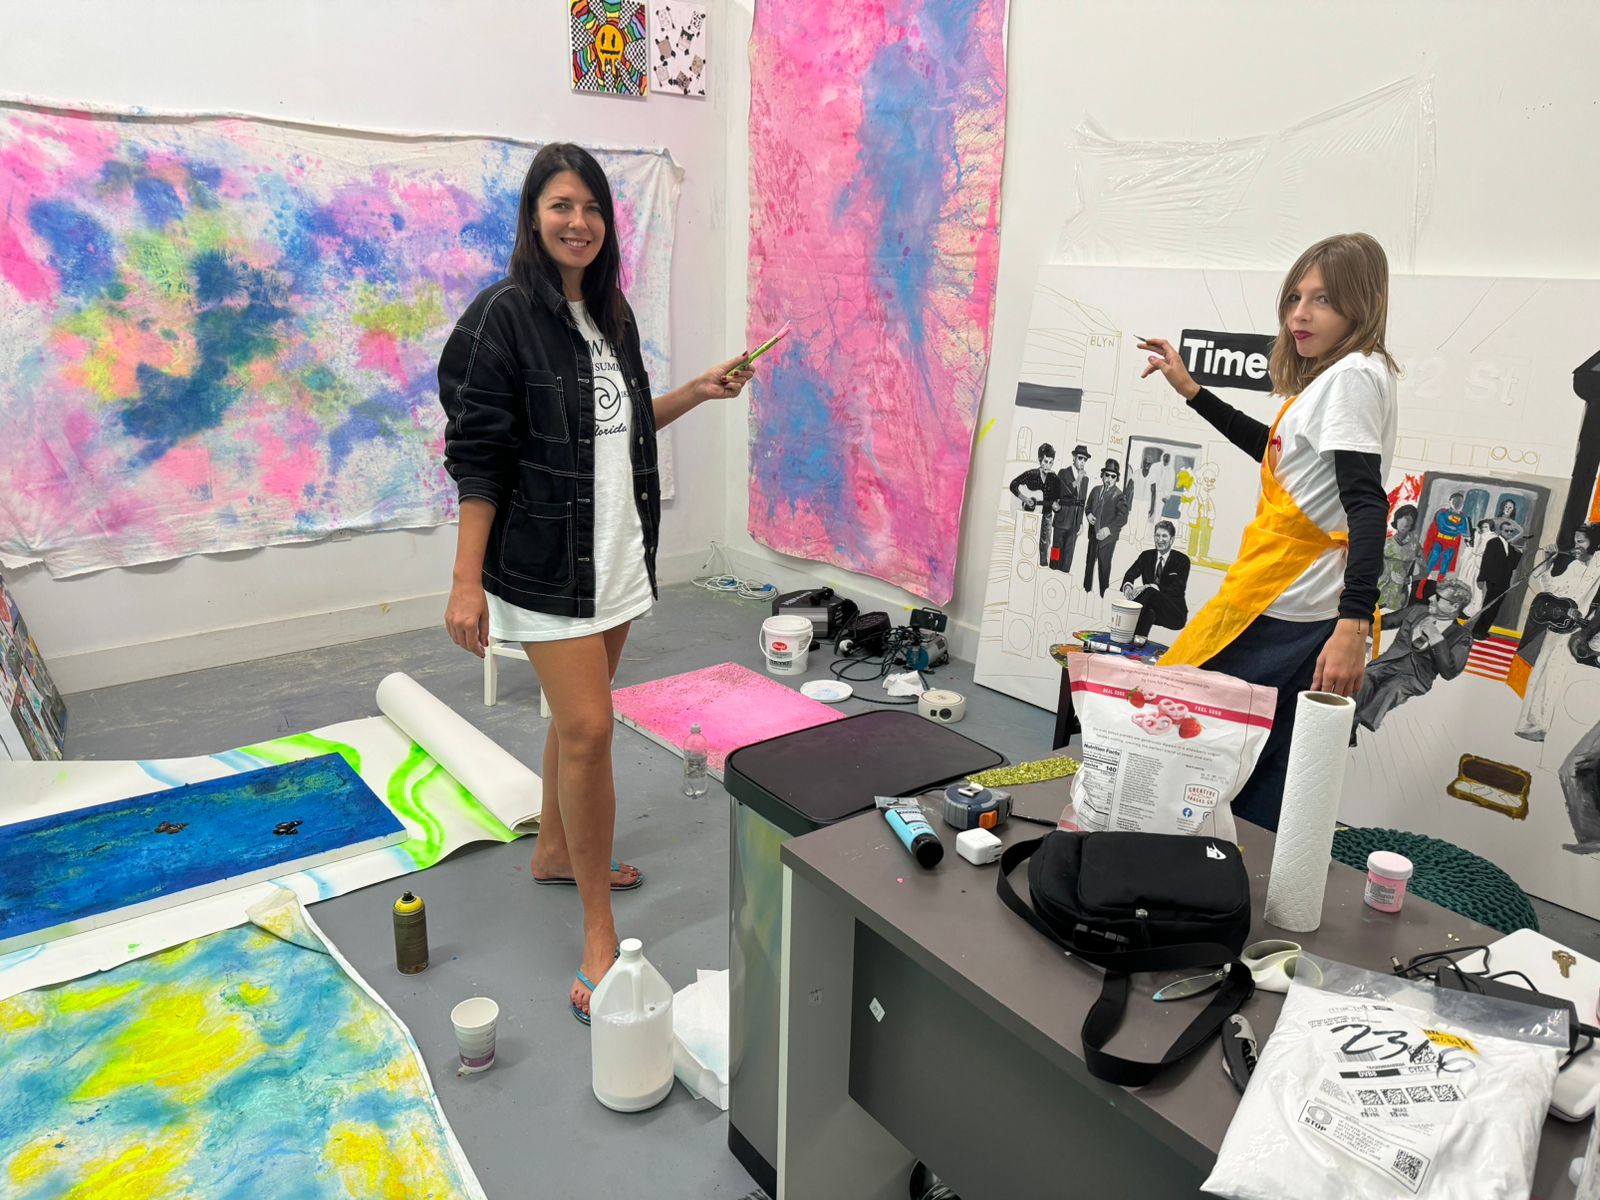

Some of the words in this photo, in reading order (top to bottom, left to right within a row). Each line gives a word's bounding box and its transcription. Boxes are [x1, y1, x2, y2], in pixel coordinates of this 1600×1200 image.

[1183, 338, 1270, 380] Time
[594, 423, 627, 437] lorida
[1083, 743, 1105, 752] Nutrition
[1187, 785, 1216, 798] CREATIVE
[1408, 1065, 1431, 1074] CYCLE
[1304, 1117, 1327, 1132] STOP
